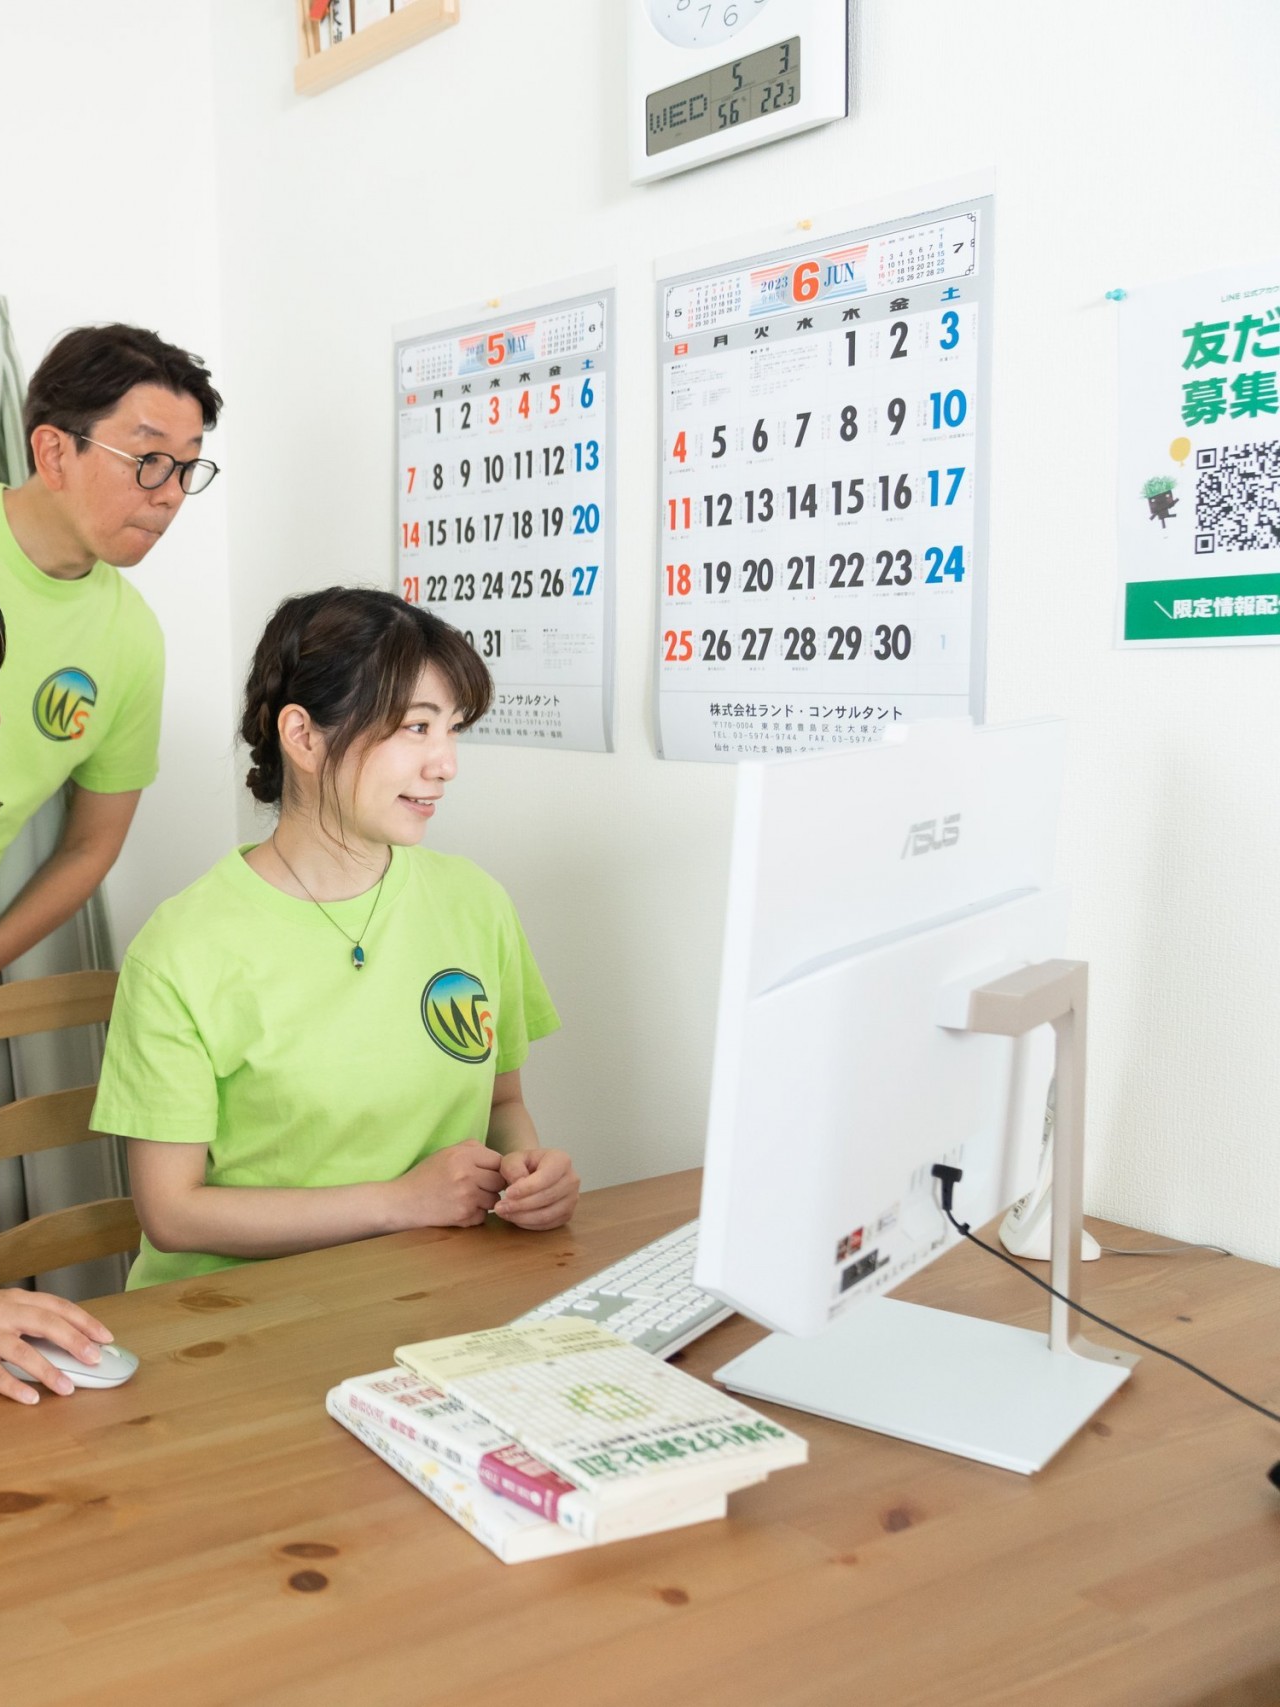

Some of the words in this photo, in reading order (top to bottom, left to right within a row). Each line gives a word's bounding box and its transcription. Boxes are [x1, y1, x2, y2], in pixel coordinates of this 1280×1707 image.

[699, 5, 712, 28] 7
[724, 5, 738, 27] 6
[732, 62, 742, 91] 5
[778, 44, 789, 74] 3
[650, 94, 707, 134] WED
[718, 99, 739, 128] 56
[760, 276, 789, 293] 2023
[792, 261, 820, 302] 6
[824, 261, 856, 287] JUN
[1220, 291, 1241, 303] LINE
[674, 343, 688, 355] 日
[714, 335, 728, 347] 月
[755, 326, 769, 339] 火
[797, 318, 813, 330] 水
[842, 308, 860, 321] 木
[890, 298, 909, 312] 金
[941, 287, 960, 301] 土
[846, 331, 855, 366] 1
[890, 322, 908, 359] 2
[940, 311, 959, 350] 3
[487, 333, 505, 365] 5
[407, 394, 416, 404] 日
[434, 389, 443, 399] 月
[462, 384, 471, 394] 火
[490, 379, 500, 388] 水
[520, 373, 530, 382] 木
[549, 366, 561, 376] 金
[582, 359, 594, 370] 土
[1181, 371, 1279, 428] 募集
[435, 407, 440, 433] 1
[461, 402, 471, 429] 2
[489, 396, 499, 425] 3
[519, 391, 529, 418] 4
[549, 385, 560, 414] 5
[581, 378, 593, 408] 6
[673, 432, 686, 463] 4
[712, 425, 726, 458] 5
[753, 419, 768, 452] 6
[795, 412, 811, 448] 7
[840, 405, 858, 441] 8
[888, 398, 906, 435] 9
[930, 389, 967, 429] 10
[408, 467, 416, 493] 7
[433, 464, 443, 490] 8
[460, 460, 470, 487] 9
[484, 455, 503, 483] 10
[515, 450, 532, 480] 11
[543, 446, 564, 476] 12
[575, 440, 599, 472] 13
[669, 498, 690, 530] 11
[704, 494, 732, 527] 12
[745, 488, 773, 523] 13
[787, 484, 817, 519] 14
[832, 479, 864, 515] 15
[879, 474, 912, 511] 16
[928, 467, 965, 506] 17
[403, 522, 419, 548] 14
[428, 519, 446, 546] 15
[456, 517, 475, 544] 16
[484, 513, 503, 541] 17
[513, 510, 532, 539] 18
[542, 507, 563, 536] 19
[573, 504, 599, 534] 20
[403, 577, 419, 603] 21
[427, 575, 447, 601] 22
[454, 574, 475, 601] 23
[483, 572, 503, 599] 24
[511, 571, 533, 598] 25
[541, 569, 564, 597] 26
[572, 566, 598, 596] 27
[666, 564, 691, 596] 18
[704, 561, 731, 594] 19
[743, 558, 773, 592] 20
[787, 556, 815, 590] 21
[829, 552, 864, 588] 22
[876, 549, 912, 586] 23
[925, 546, 965, 583] 24
[1172, 594, 1280, 620] 限定情報配
[483, 630, 500, 657] 31
[665, 630, 692, 661] 25
[702, 629, 731, 661] 26
[741, 628, 773, 660] 27
[784, 627, 816, 661] 28
[828, 626, 862, 660] 29
[874, 624, 911, 660] 30
[710, 703, 902, 721] 株式会社ランド・コンサルタント
[761, 722, 886, 733] 東京都豊島区北大塚2-
[901, 813, 961, 859] ASUS
